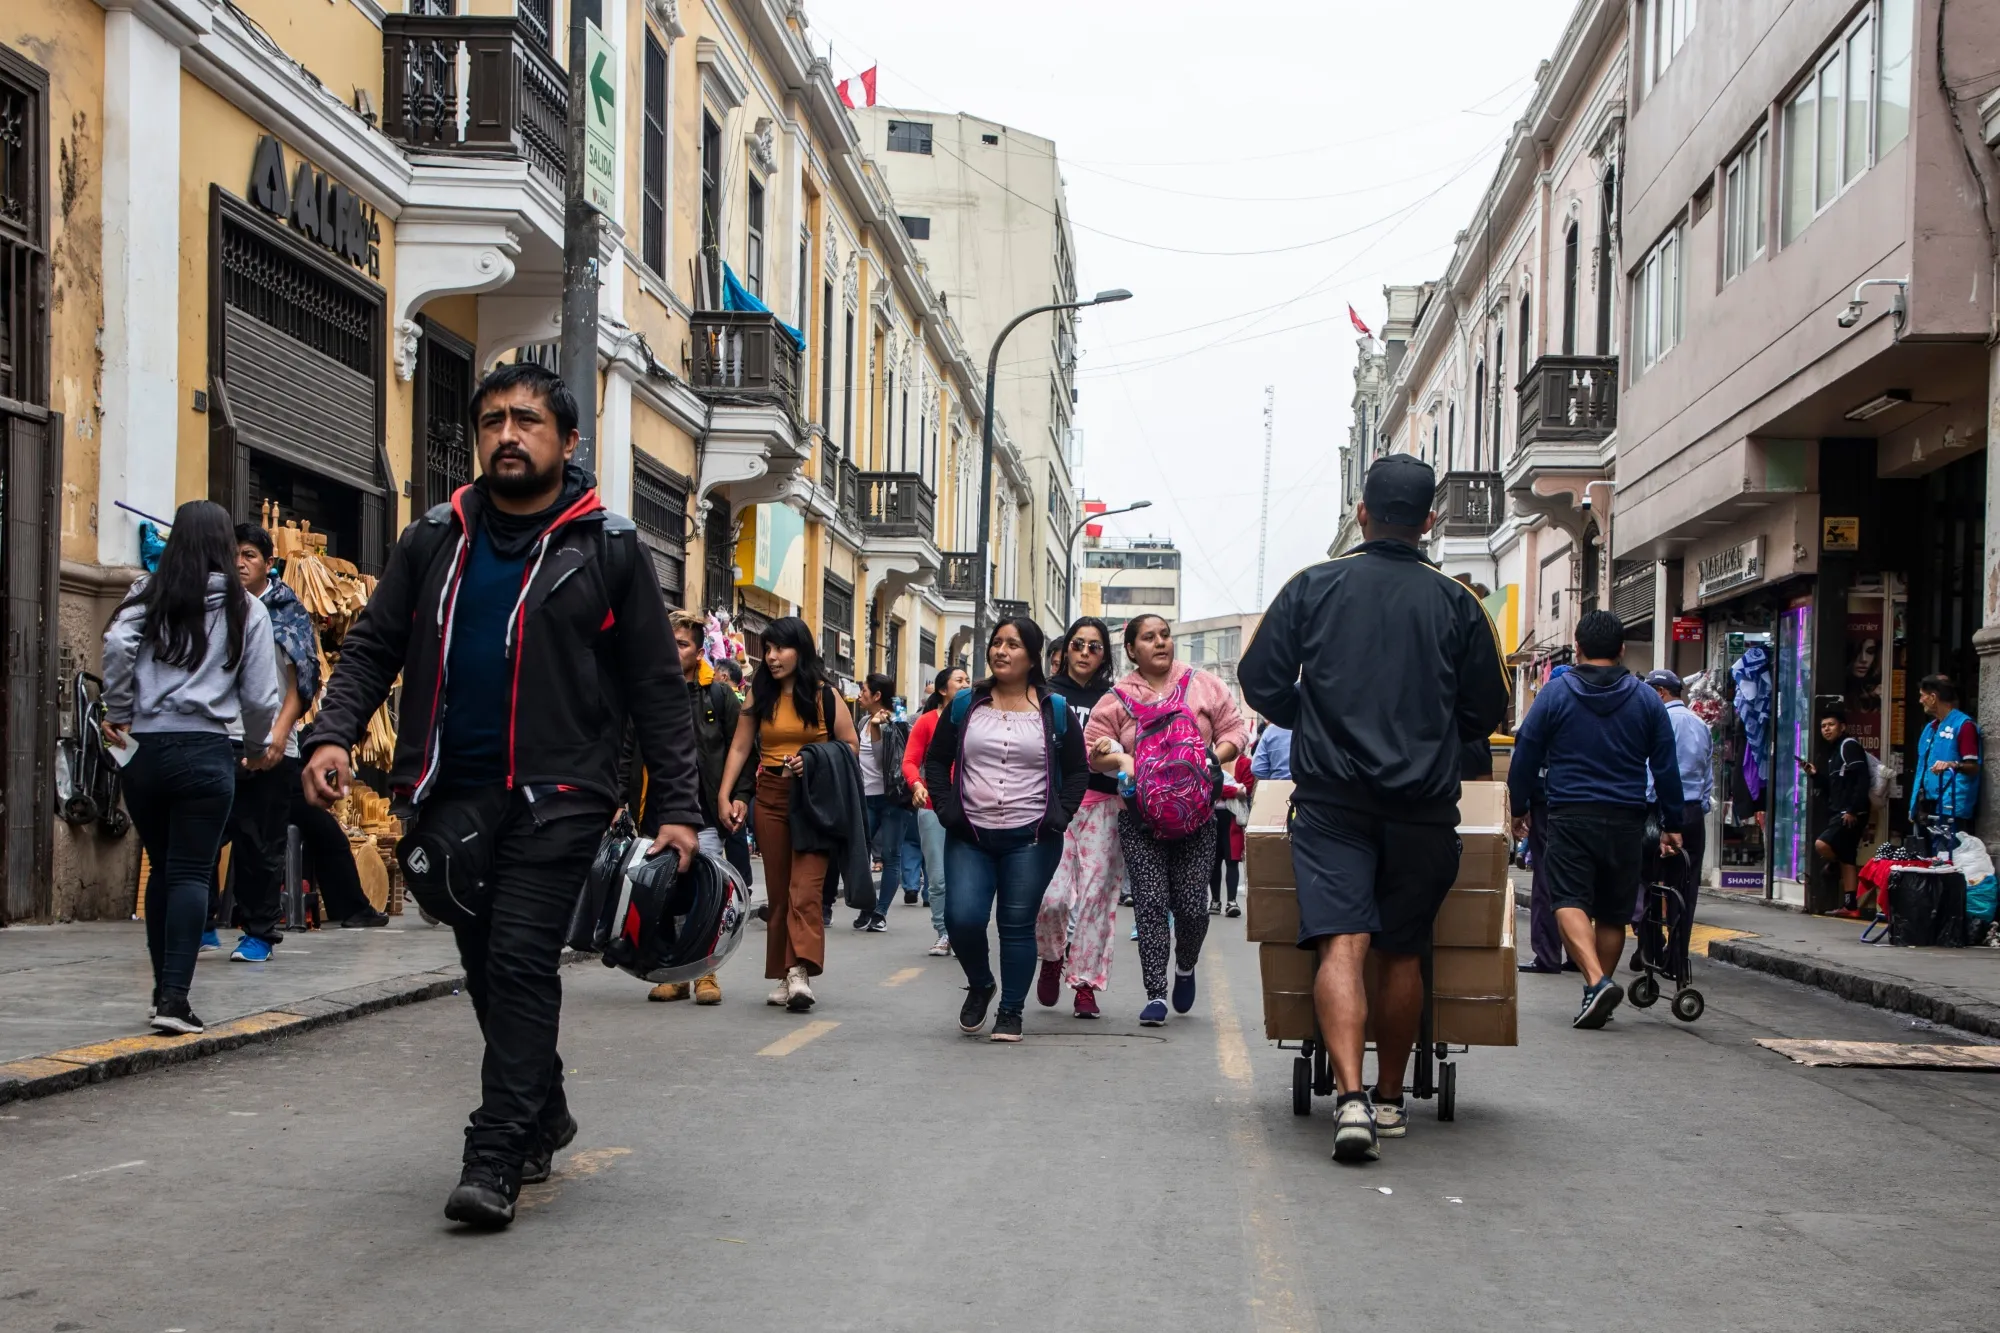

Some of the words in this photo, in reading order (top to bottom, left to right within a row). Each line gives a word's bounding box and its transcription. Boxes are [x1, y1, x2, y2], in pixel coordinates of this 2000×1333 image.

[589, 144, 612, 180] SALIDA
[293, 160, 366, 268] ALFA
[1858, 736, 1880, 749] TUBO
